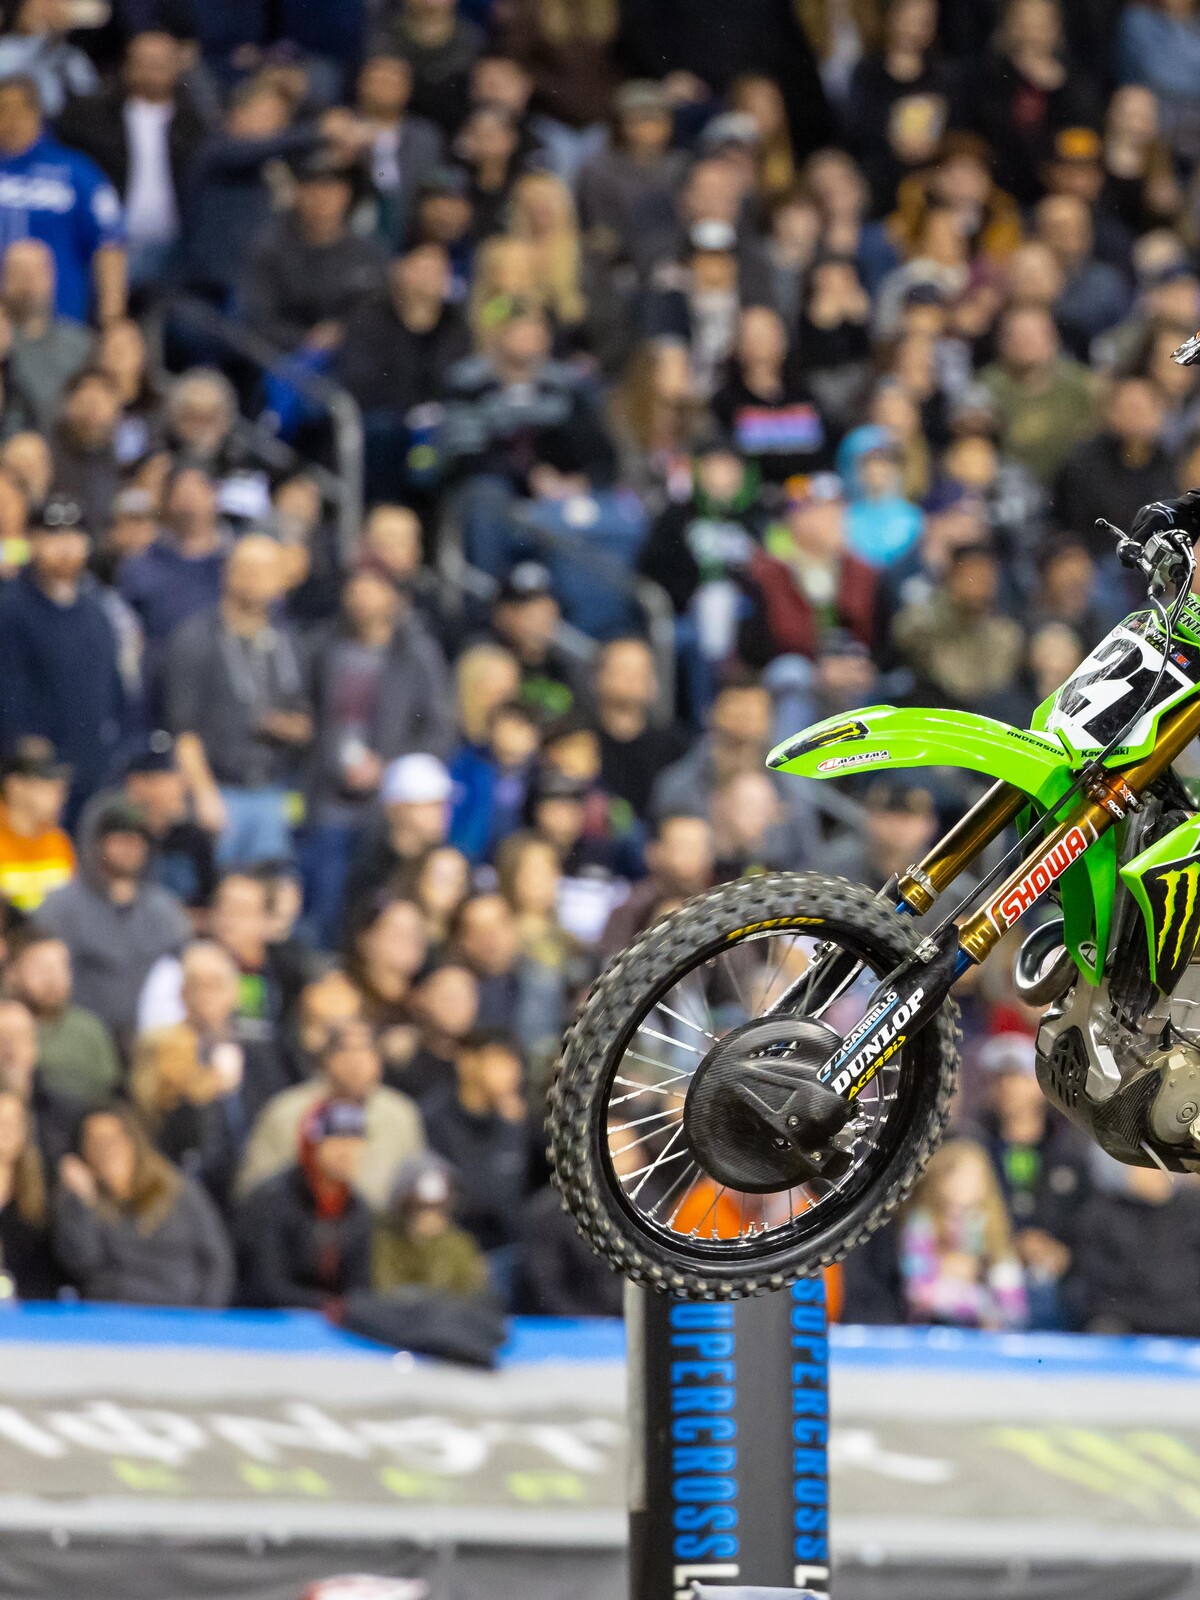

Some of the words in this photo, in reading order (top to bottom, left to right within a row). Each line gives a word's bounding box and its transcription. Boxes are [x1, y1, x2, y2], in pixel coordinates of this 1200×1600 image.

[1006, 730, 1065, 757] ANDERSON
[1058, 638, 1184, 747] 21
[1000, 826, 1088, 928] SHOWA
[830, 987, 924, 1096] DUNLOP
[842, 991, 898, 1050] CARRILLO
[670, 1303, 739, 1560] UPERCROSS
